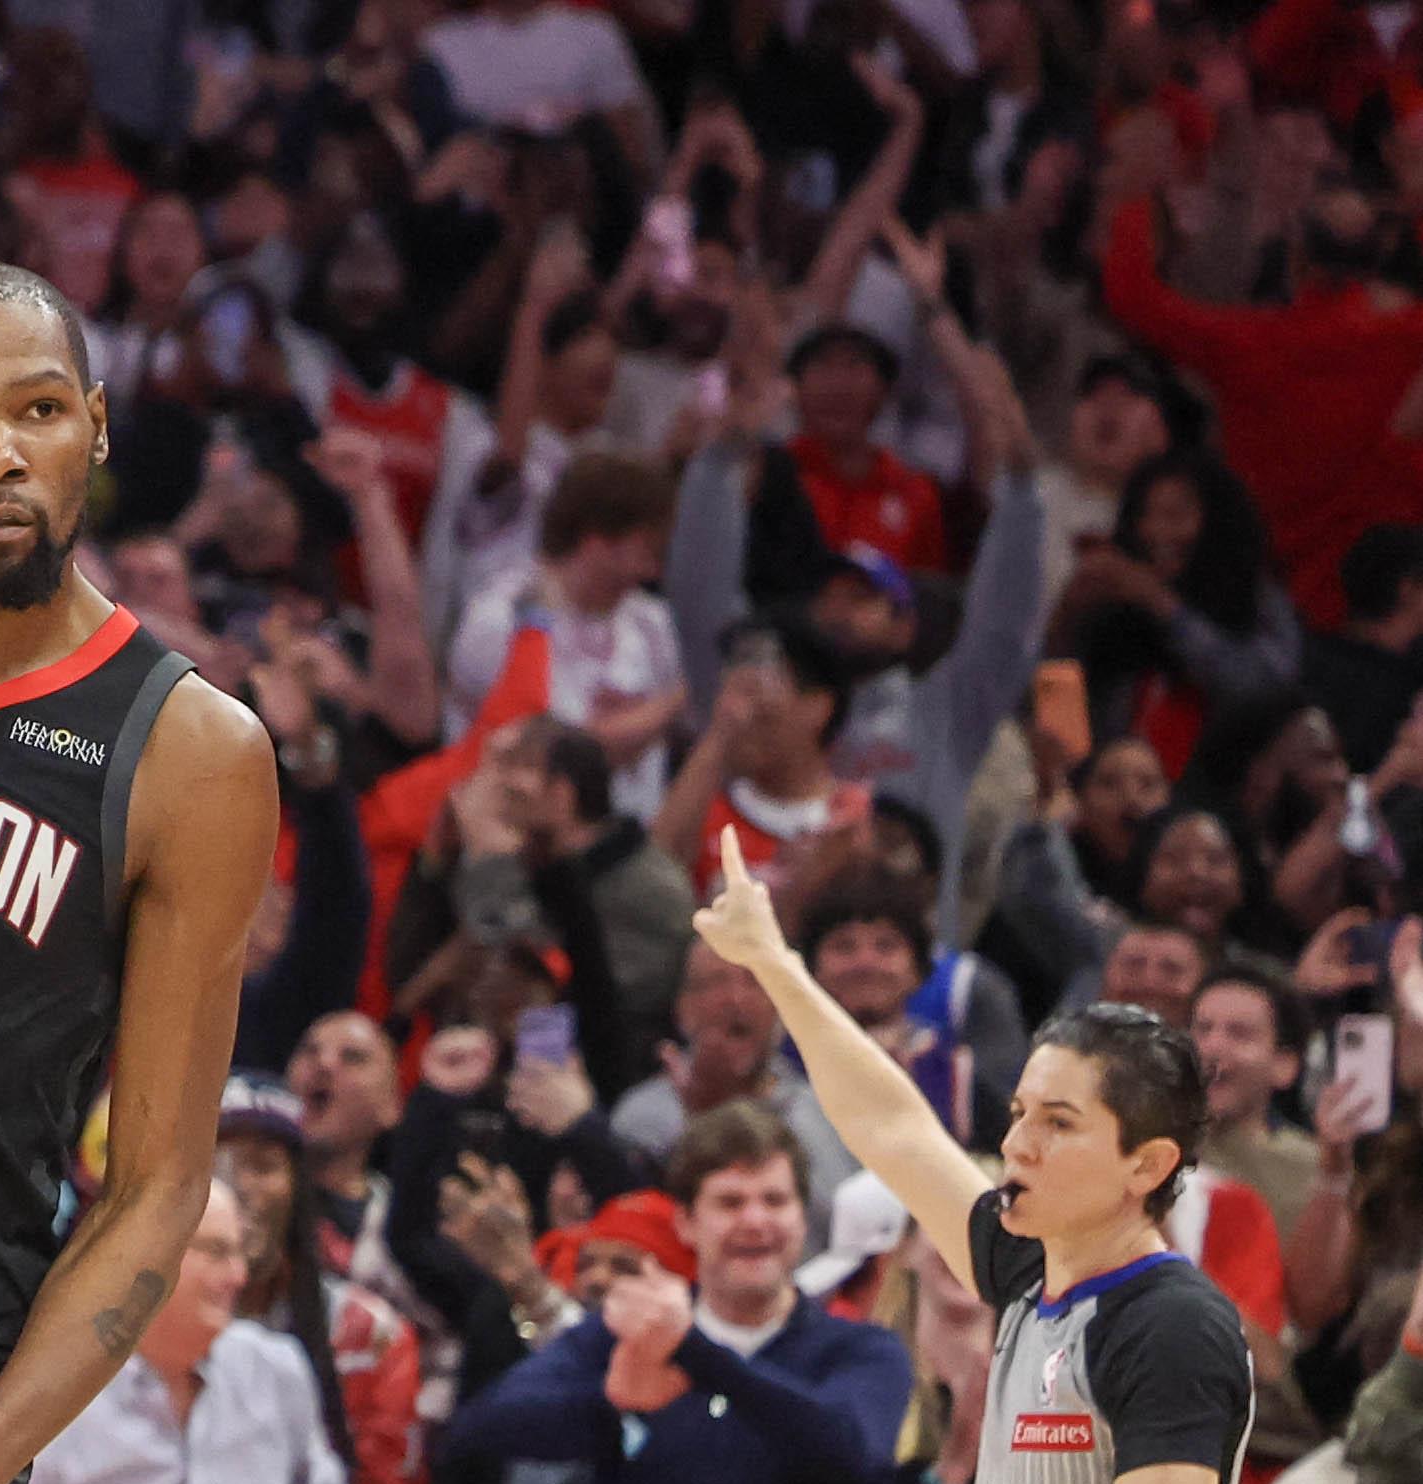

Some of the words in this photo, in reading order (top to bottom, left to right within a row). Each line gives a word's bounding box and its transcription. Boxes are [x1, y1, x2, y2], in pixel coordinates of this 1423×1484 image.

[9, 729, 105, 767] HERMANN
[12, 717, 105, 757] MEMORIAL
[1013, 1418, 1091, 1444] Emirates
